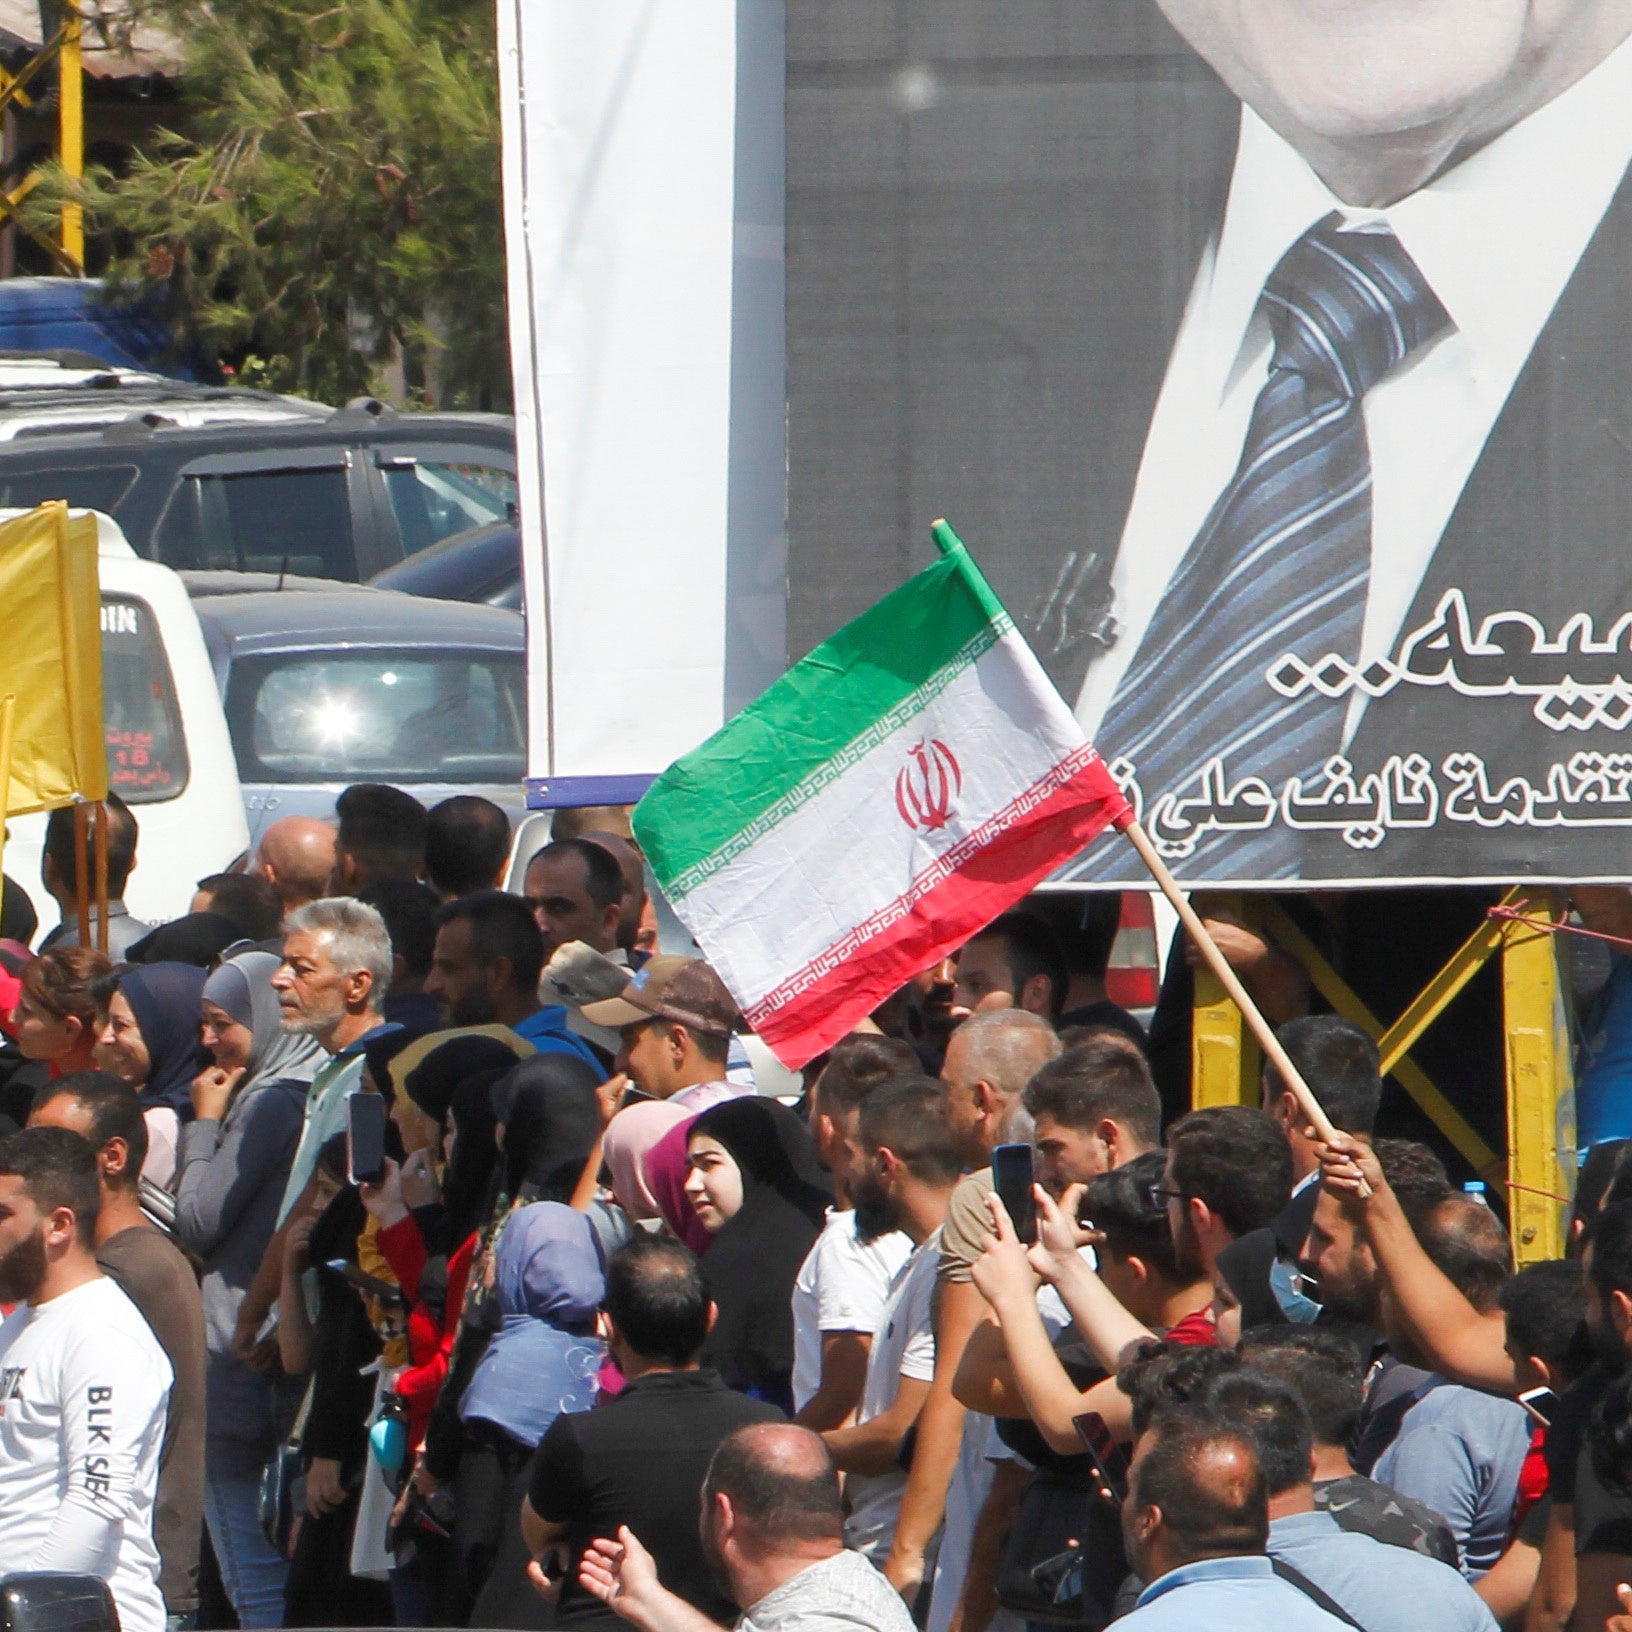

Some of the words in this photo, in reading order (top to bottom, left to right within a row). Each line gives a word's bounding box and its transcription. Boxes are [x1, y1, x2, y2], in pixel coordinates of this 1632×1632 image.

[1148, 756, 1280, 858] علي
[1281, 752, 1440, 850] نايف
[87, 1385, 113, 1445] BLK
